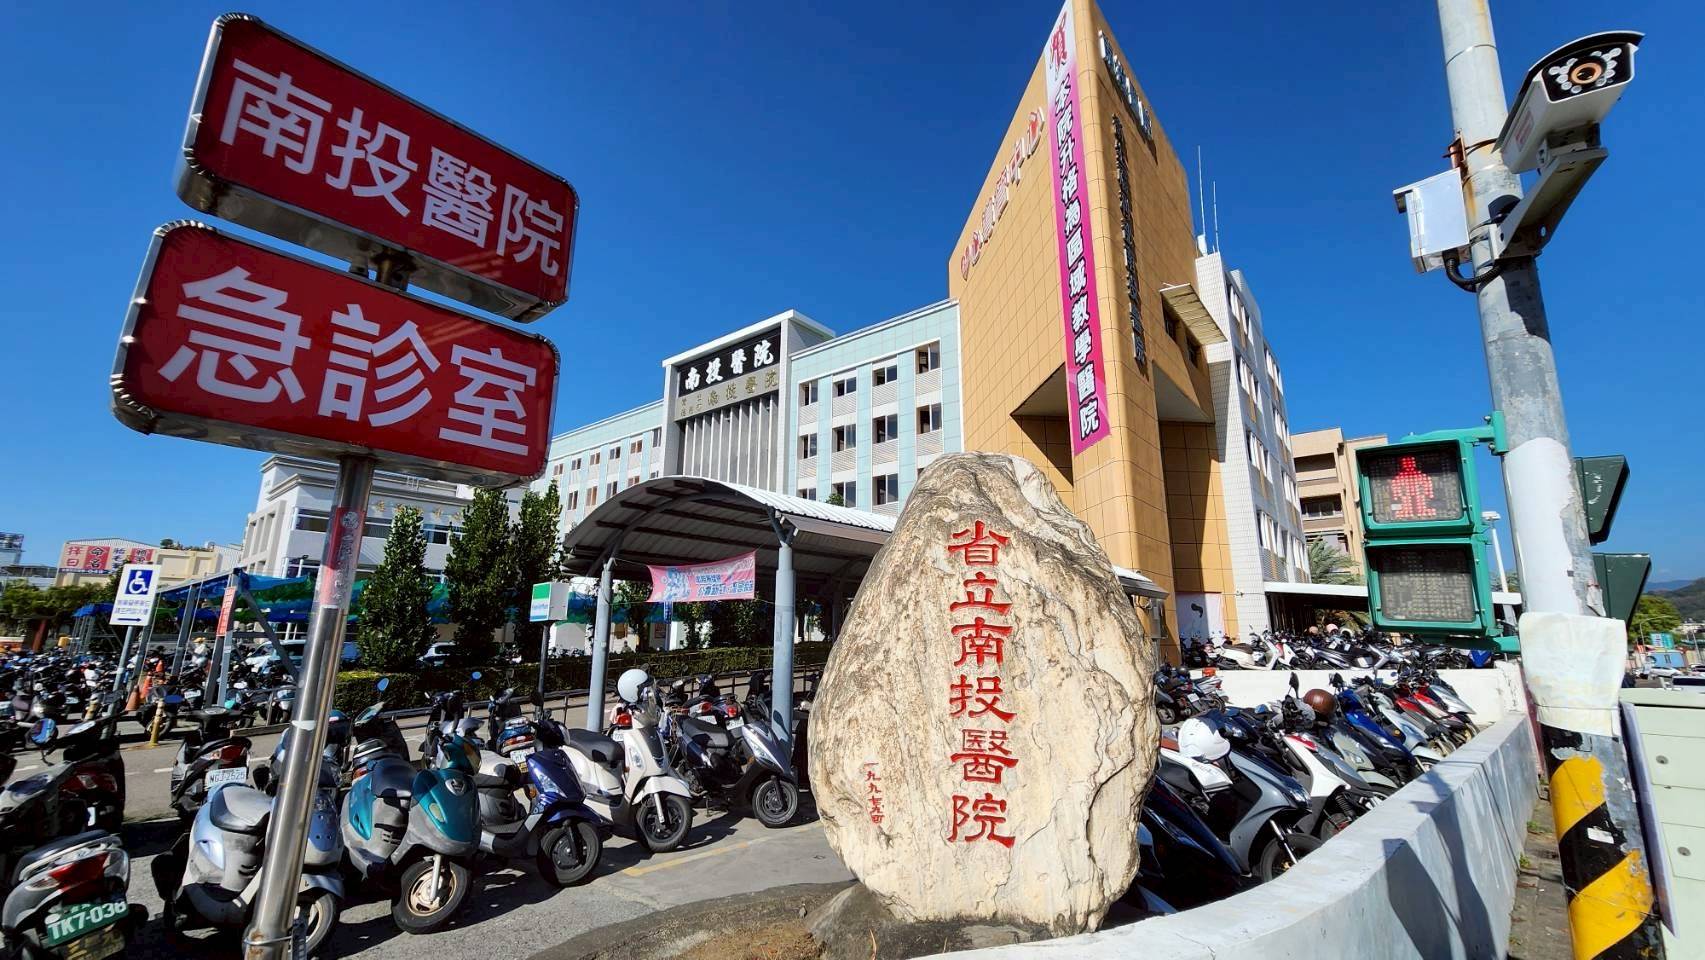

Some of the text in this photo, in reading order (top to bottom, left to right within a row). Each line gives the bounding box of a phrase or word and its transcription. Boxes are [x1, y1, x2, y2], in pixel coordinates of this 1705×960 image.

[219, 57, 565, 277] 南投醫院
[1055, 73, 1100, 442] 本院升格為區域教學醫院
[158, 265, 537, 457] 急診室
[684, 339, 775, 391] 南投醫院
[947, 520, 1019, 849] 省立南投醫院
